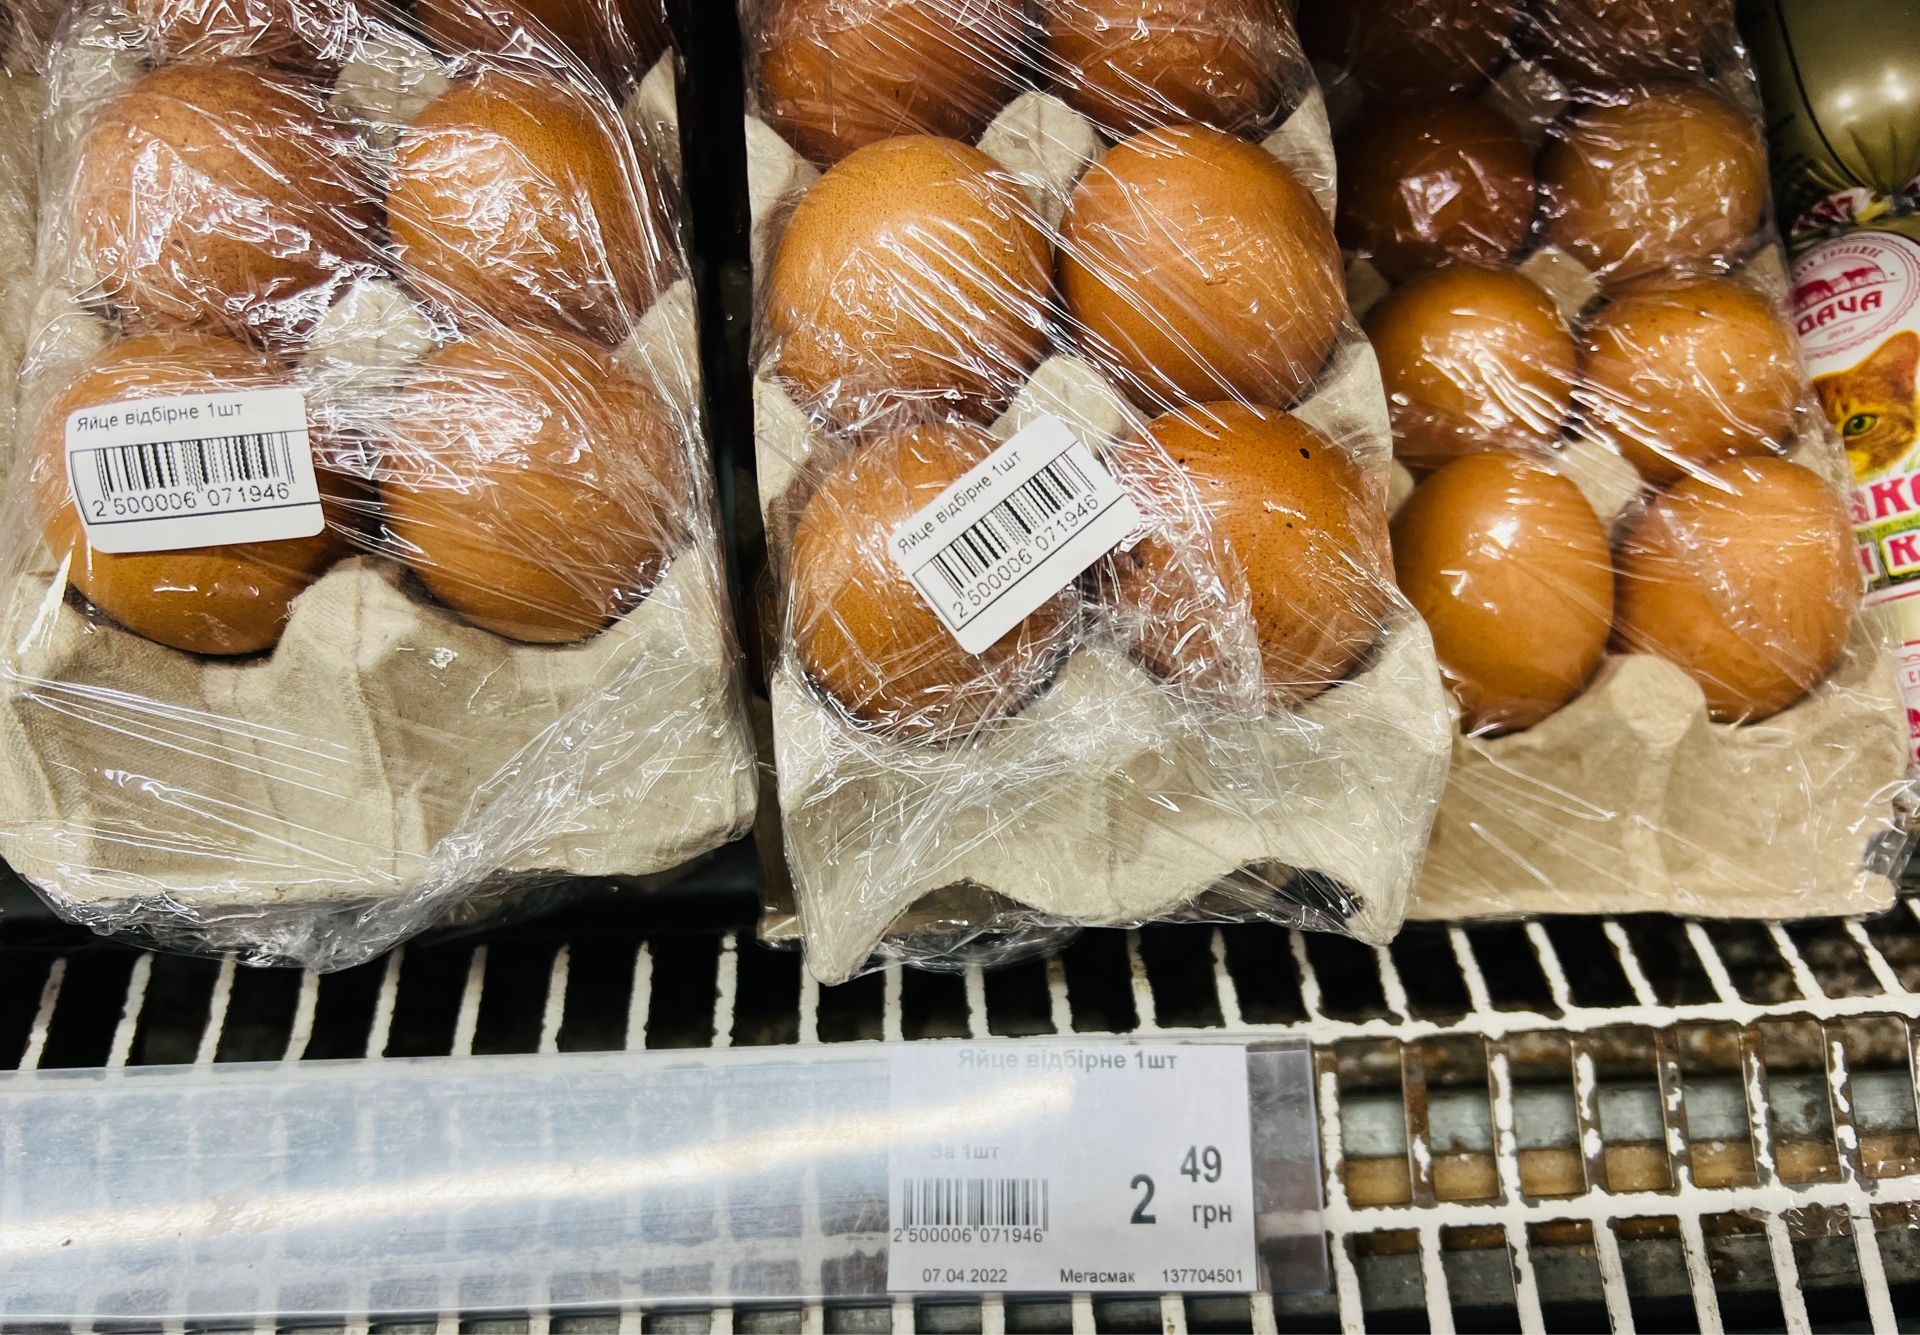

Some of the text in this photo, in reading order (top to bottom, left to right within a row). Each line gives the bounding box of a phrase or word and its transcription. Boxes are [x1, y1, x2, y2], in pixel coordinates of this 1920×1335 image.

[77, 402, 243, 432] Яйце відбірне 1шт
[92, 482, 290, 517] 2 500006 071946
[897, 451, 1021, 555] Яйце відбірне 1шт
[952, 494, 1099, 619] 2 500006 071946
[958, 1049, 1179, 1073] Яйце відбірне 1шт
[930, 1143, 1000, 1160] За 1шт
[1129, 1145, 1222, 1225] 2 49
[1191, 1203, 1232, 1229] грн
[893, 1228, 1044, 1243] 2 500006 071946
[922, 1268, 1243, 1285] 07.04.2022 Мегасмак 137704501
